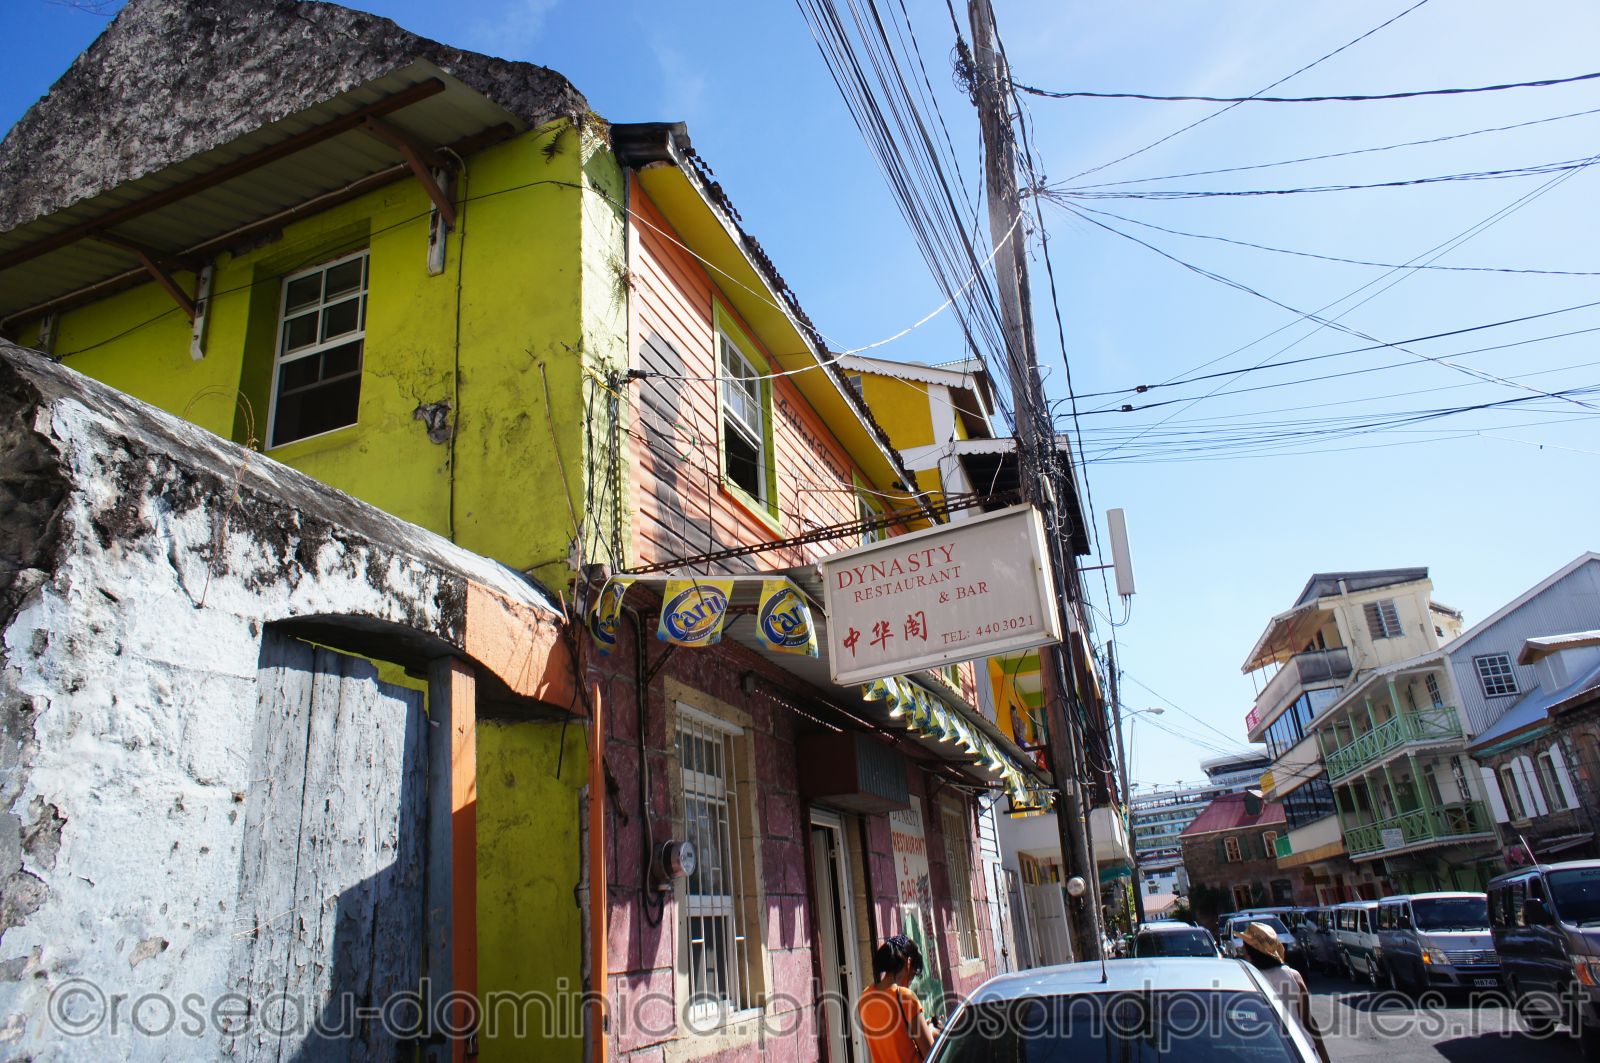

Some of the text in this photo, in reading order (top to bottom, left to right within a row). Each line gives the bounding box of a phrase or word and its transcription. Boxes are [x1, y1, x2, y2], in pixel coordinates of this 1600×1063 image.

[837, 543, 956, 589] DYNASTY
[854, 566, 961, 602] RESTAURANT
[938, 581, 989, 604] & BAR
[843, 610, 928, 658] 中华阁
[941, 615, 1034, 645] TEL: 4403021
